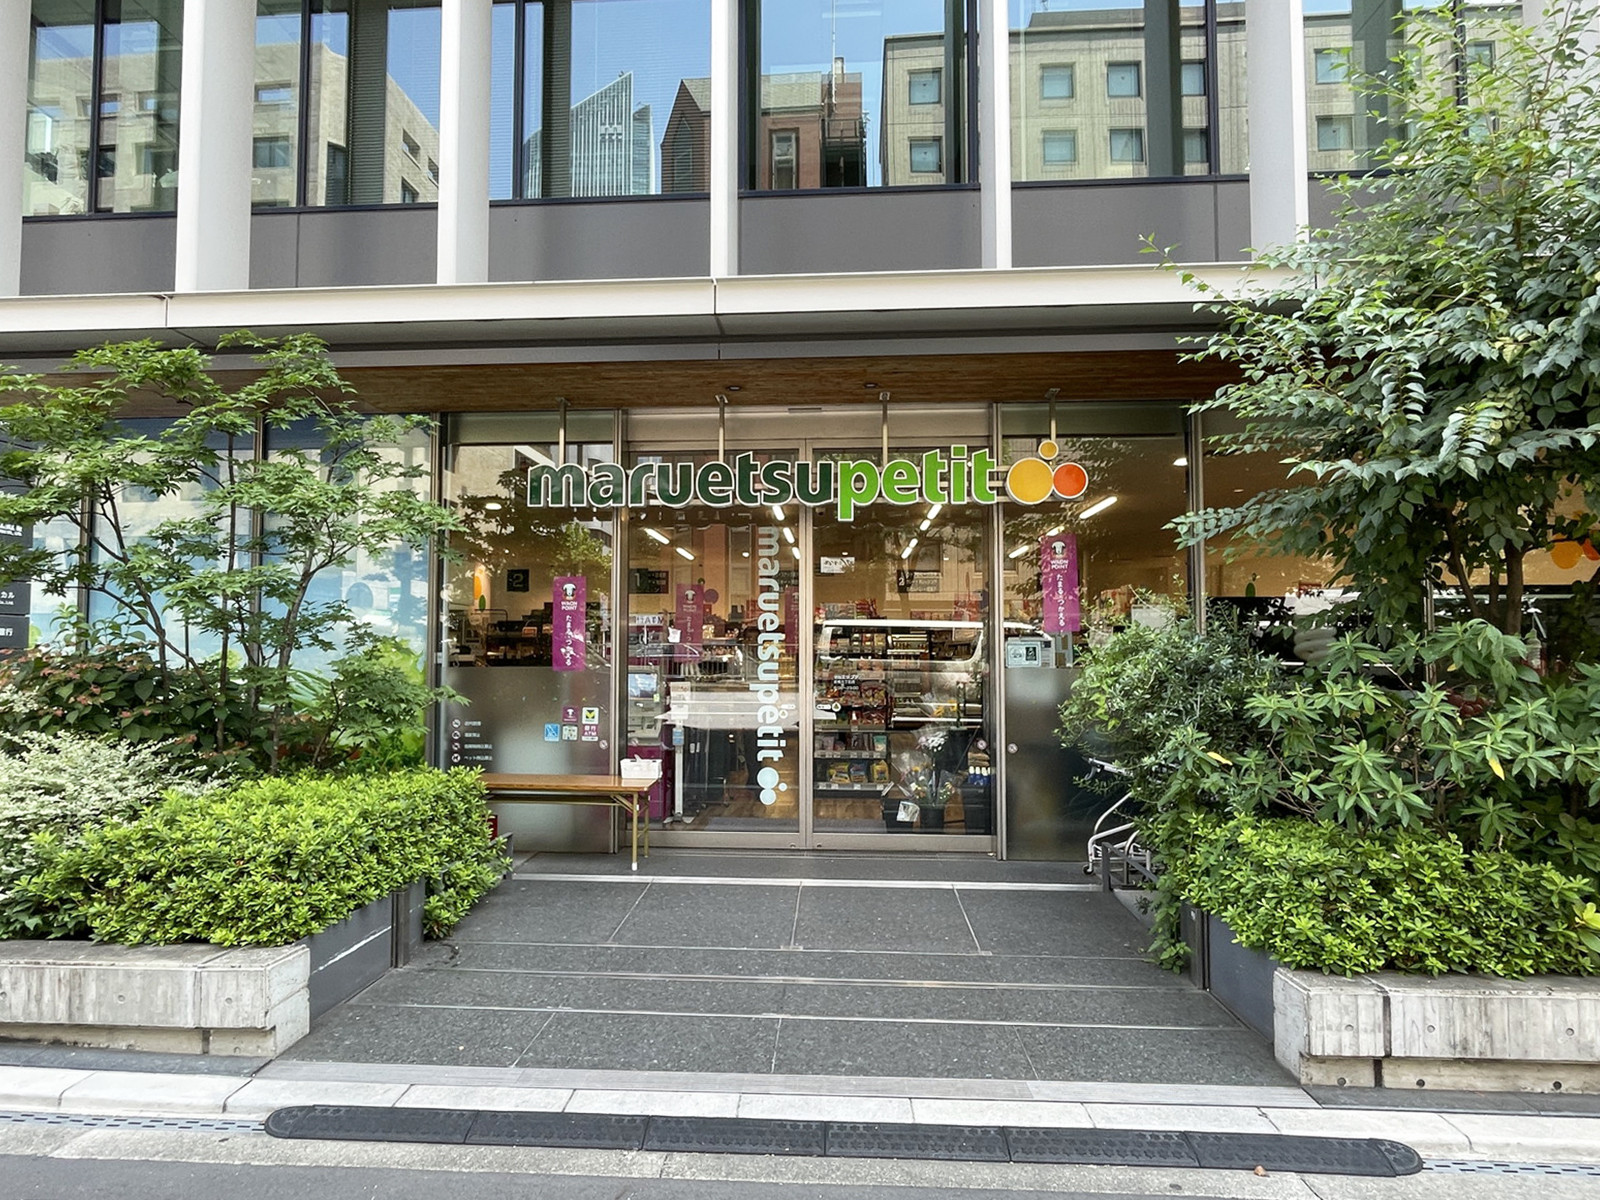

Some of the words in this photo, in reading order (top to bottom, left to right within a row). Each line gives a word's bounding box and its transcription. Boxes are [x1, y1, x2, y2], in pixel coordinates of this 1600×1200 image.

[526, 444, 997, 522] maruetsupetit
[512, 573, 524, 588] 2
[749, 526, 786, 762] maruetsupetit
